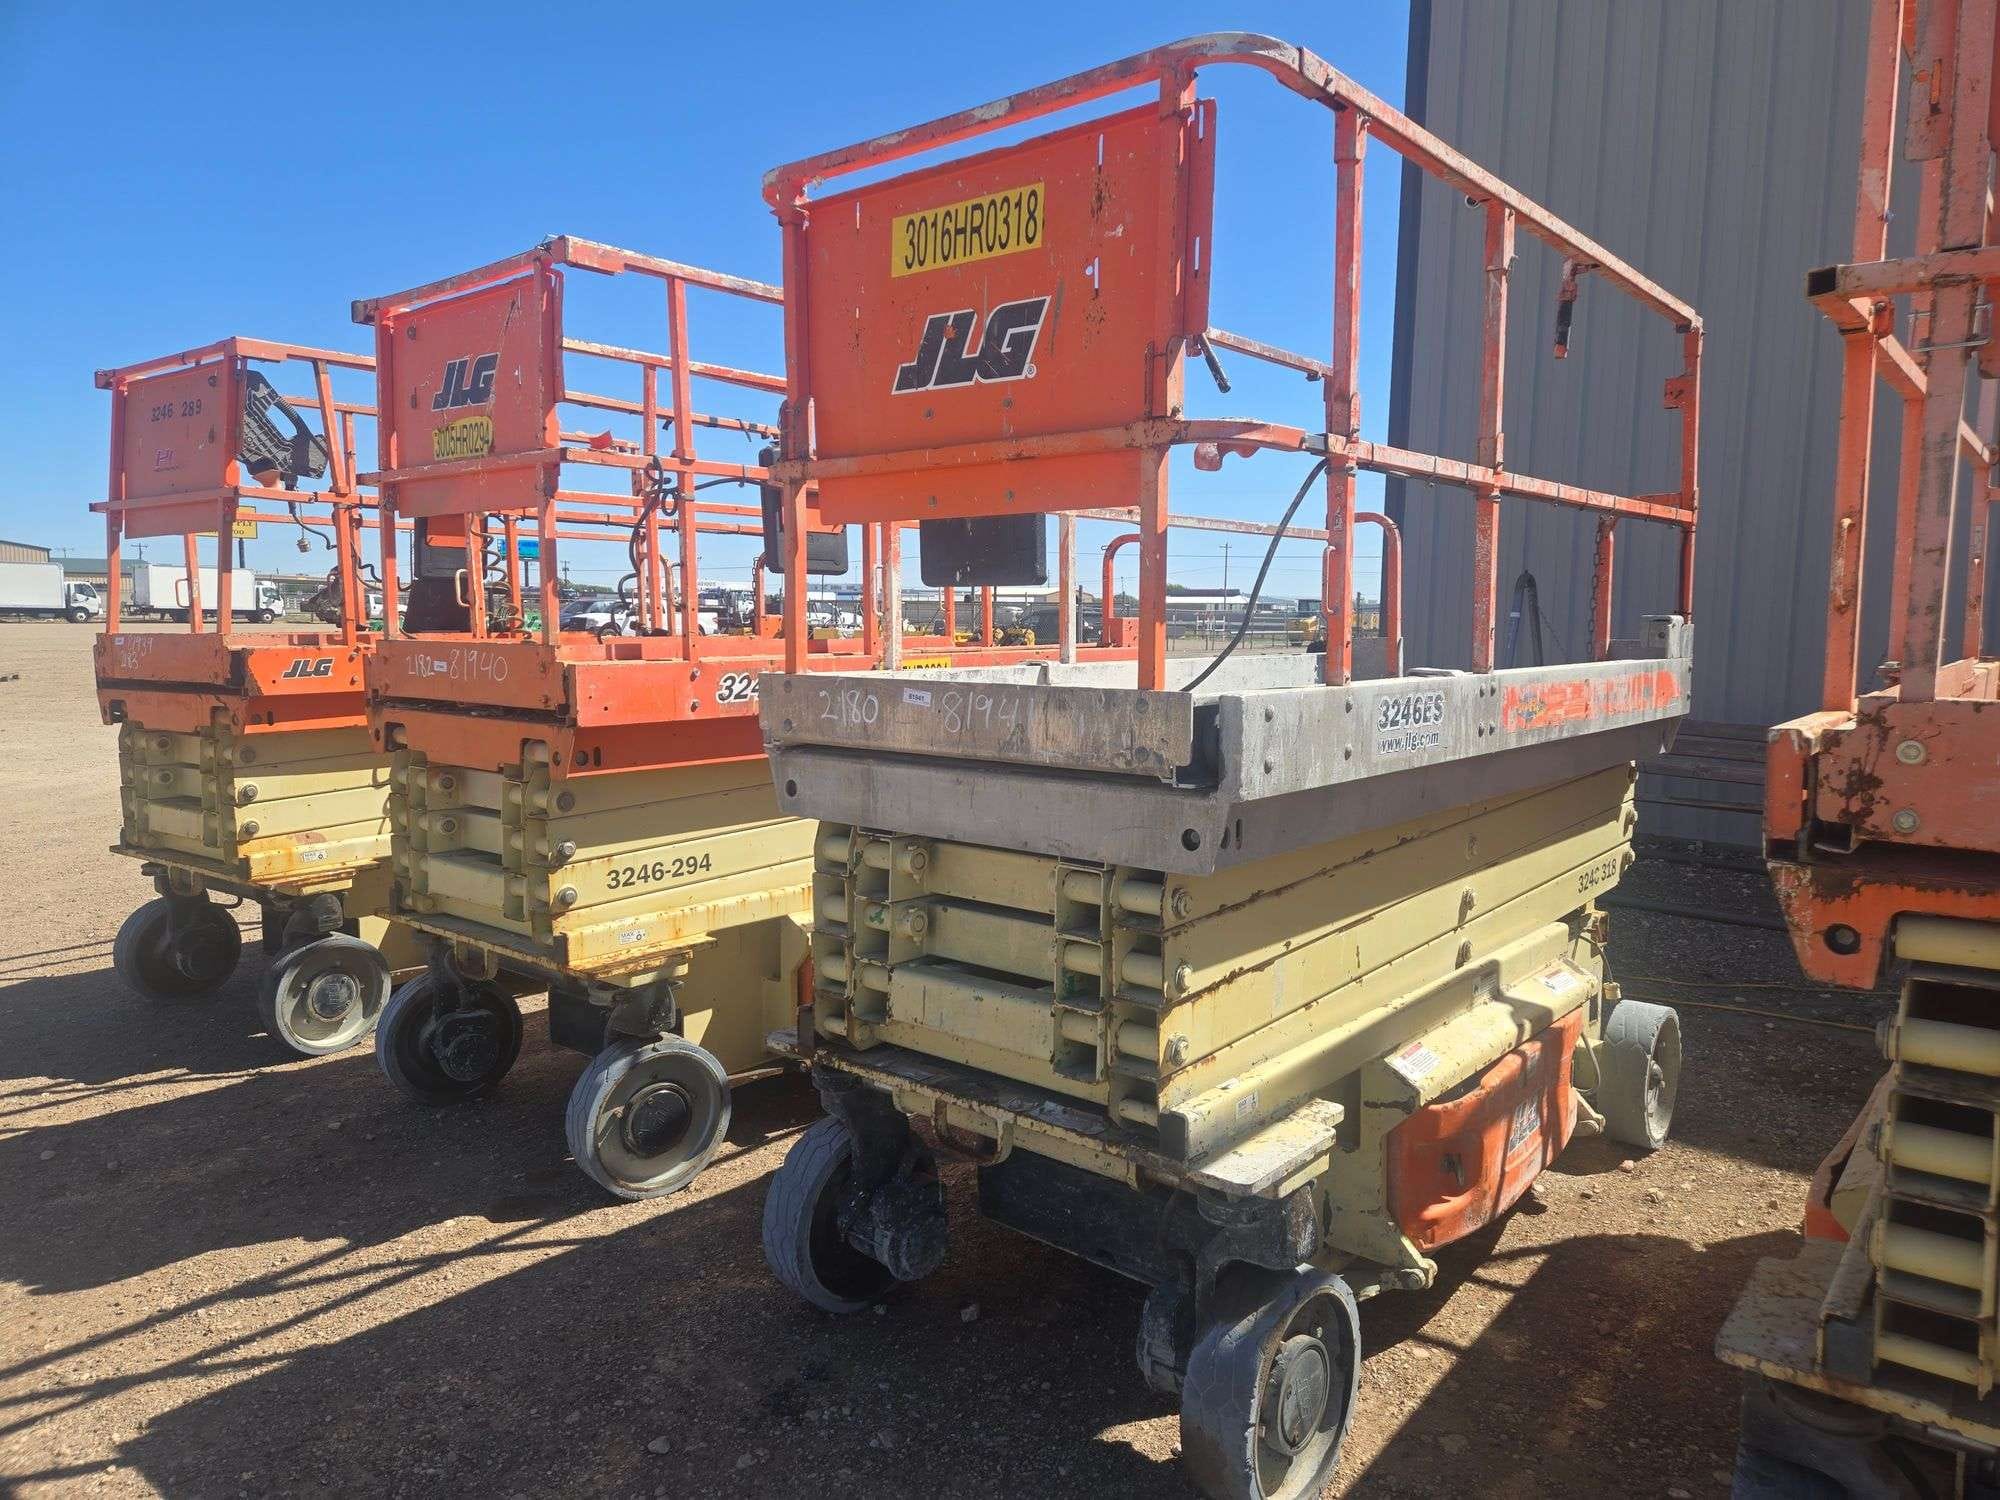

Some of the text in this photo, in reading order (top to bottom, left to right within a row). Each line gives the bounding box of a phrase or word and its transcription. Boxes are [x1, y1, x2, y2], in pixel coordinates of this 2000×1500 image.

[904, 188, 1039, 270] 3016HR0318
[891, 295, 1052, 395] JLG
[432, 352, 500, 412] JLG
[182, 399, 202, 417] 289
[282, 657, 334, 680] JLG
[449, 649, 508, 681] 81940
[819, 690, 880, 724] 2180
[1378, 693, 1444, 731] 3246ES
[1379, 731, 1440, 752] www.jlg.com
[606, 852, 713, 891] 3246-294
[1601, 858, 1617, 881] 318
